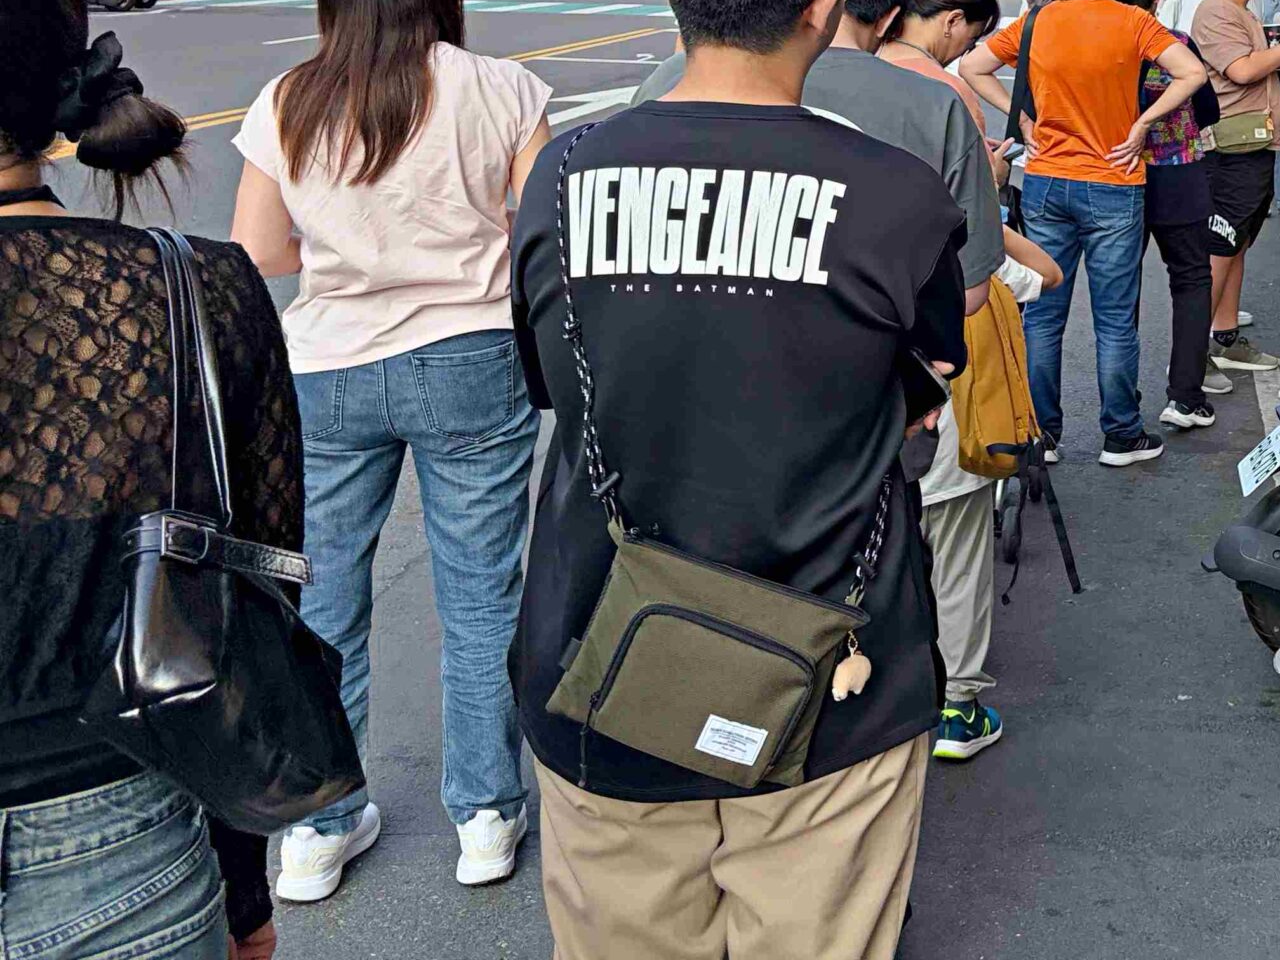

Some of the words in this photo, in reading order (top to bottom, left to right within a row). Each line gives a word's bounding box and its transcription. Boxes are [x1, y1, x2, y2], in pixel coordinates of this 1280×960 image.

[568, 166, 847, 286] VENGEANCE
[610, 283, 650, 293] THE
[676, 283, 774, 297] BATMAN
